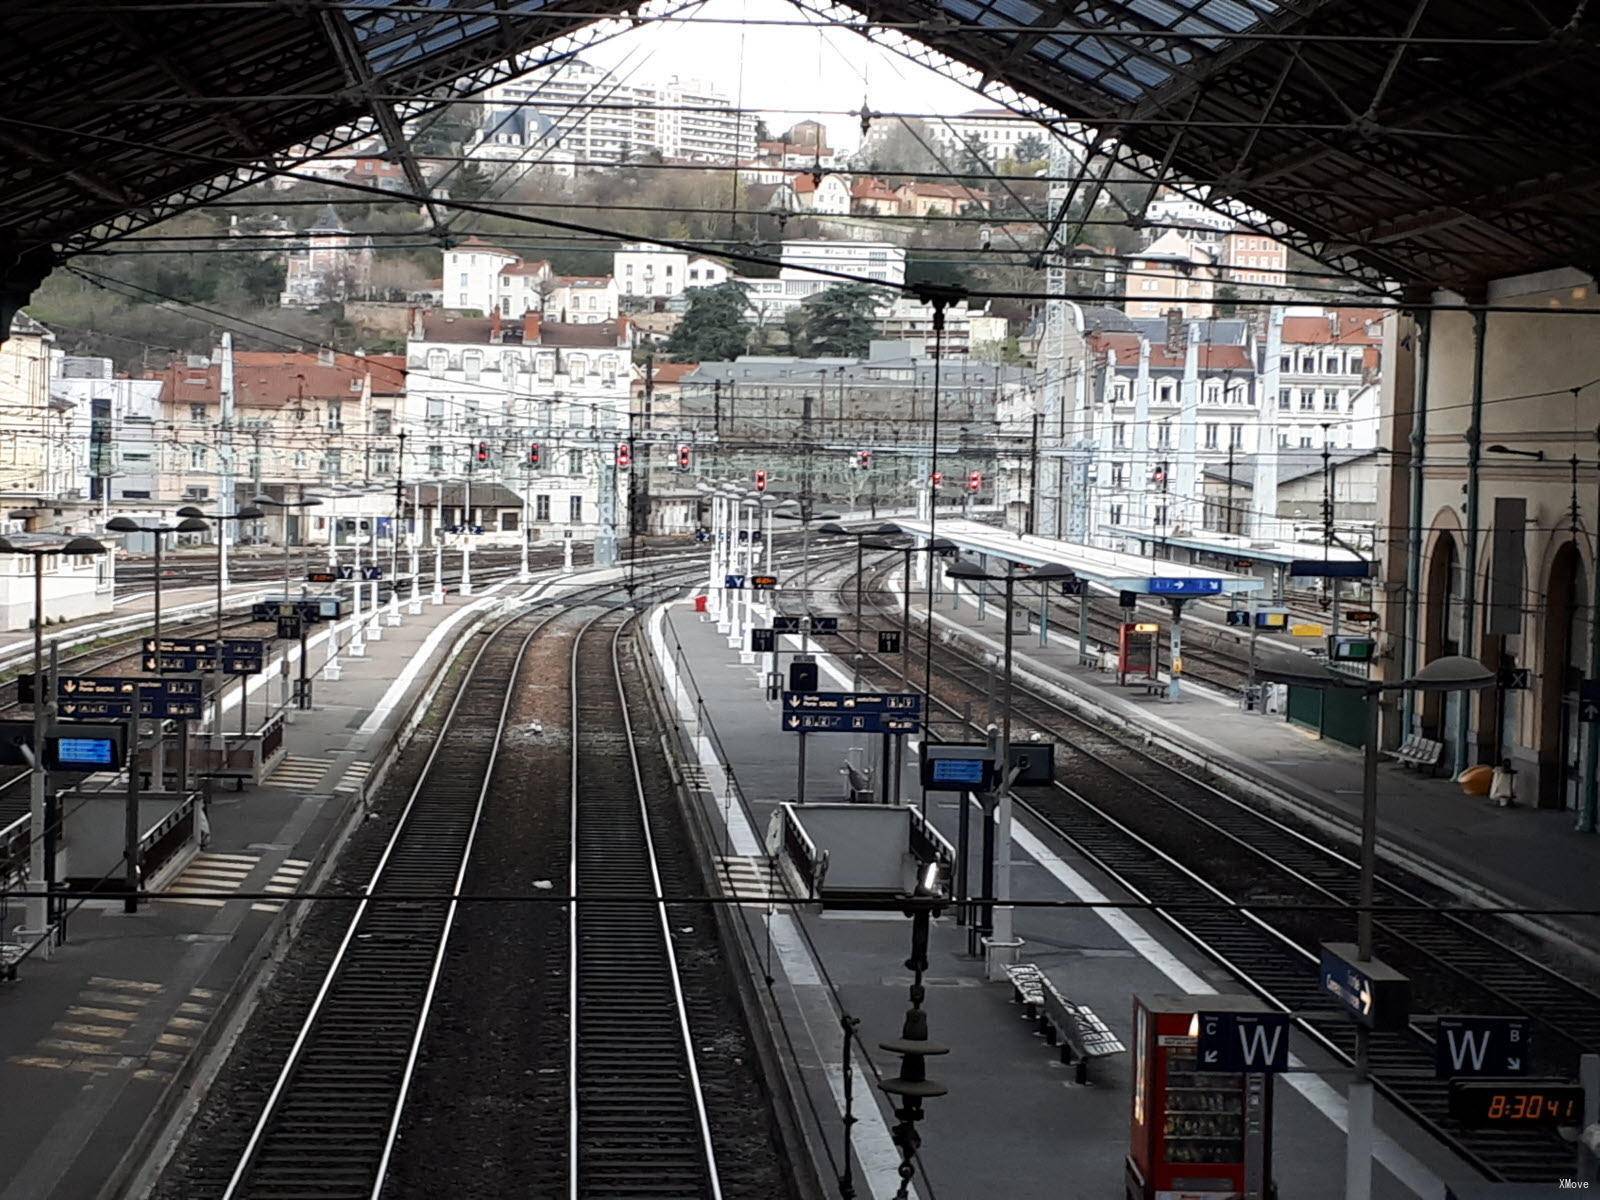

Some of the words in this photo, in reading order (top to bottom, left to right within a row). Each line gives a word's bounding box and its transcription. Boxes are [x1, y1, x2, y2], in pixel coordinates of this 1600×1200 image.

[341, 568, 350, 578] Y
[363, 568, 373, 578] Y
[734, 578, 743, 587] Y
[1511, 672, 1524, 687] X
[1206, 1022, 1217, 1035] C
[1510, 1030, 1520, 1042] B
[1238, 1024, 1282, 1066] W
[1446, 1030, 1491, 1071] W
[1488, 1095, 1543, 1119] 8:30
